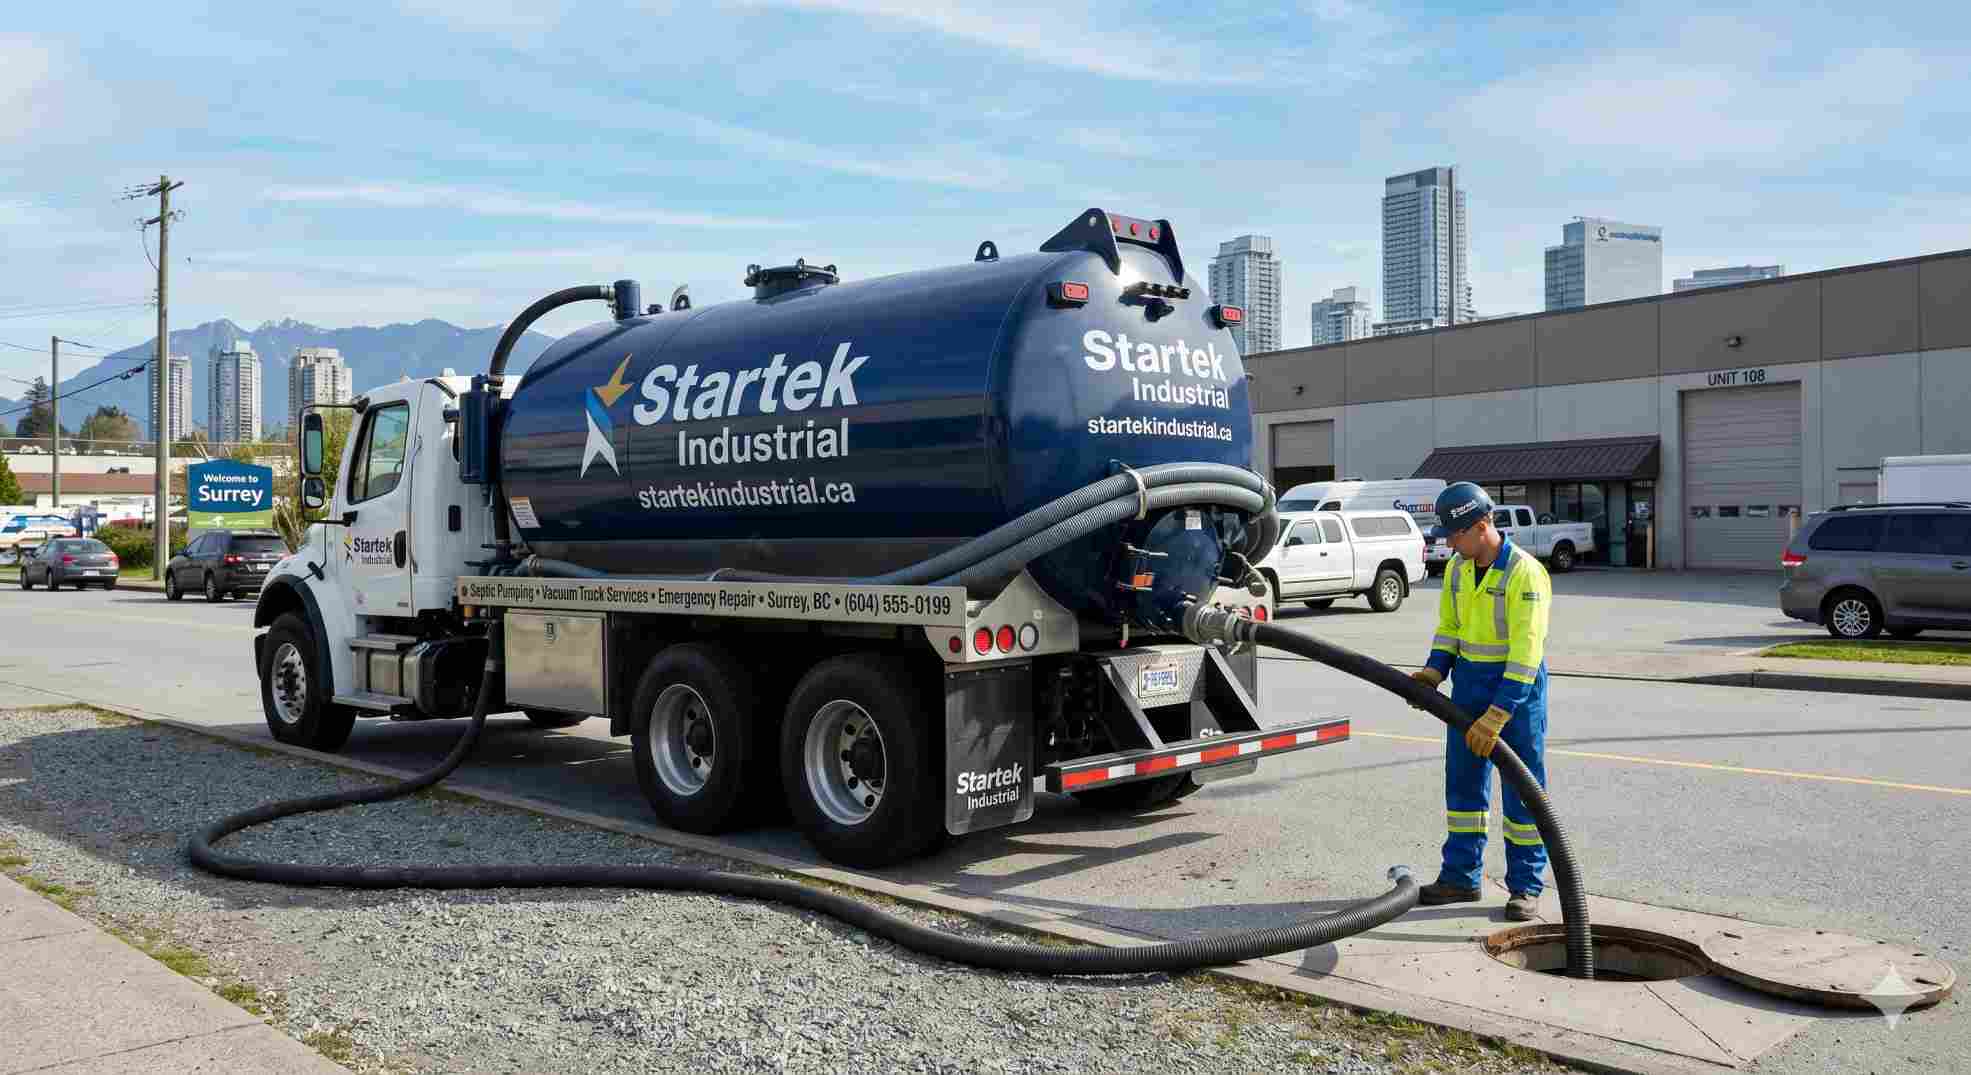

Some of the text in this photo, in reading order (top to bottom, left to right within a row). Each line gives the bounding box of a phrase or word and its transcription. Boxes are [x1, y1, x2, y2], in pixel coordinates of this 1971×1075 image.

[1082, 329, 1227, 383] Startek
[632, 342, 871, 426] Startek
[1132, 376, 1231, 410] Industrial
[1707, 368, 1766, 386] UNIT 108
[678, 417, 850, 467] Industrial
[1087, 416, 1233, 442] startekindustrial.ca
[202, 472, 259, 484] Welcome to
[638, 476, 856, 510] startekindustrial.ca
[198, 484, 264, 507] Surrey
[353, 536, 393, 553] Startek
[470, 583, 951, 617] Septic Pumping Vacuum Truck Services Emergency Repair Surrey, BC (604) 555-0199
[956, 762, 1023, 795] Startek
[968, 784, 1019, 810] Industrial
